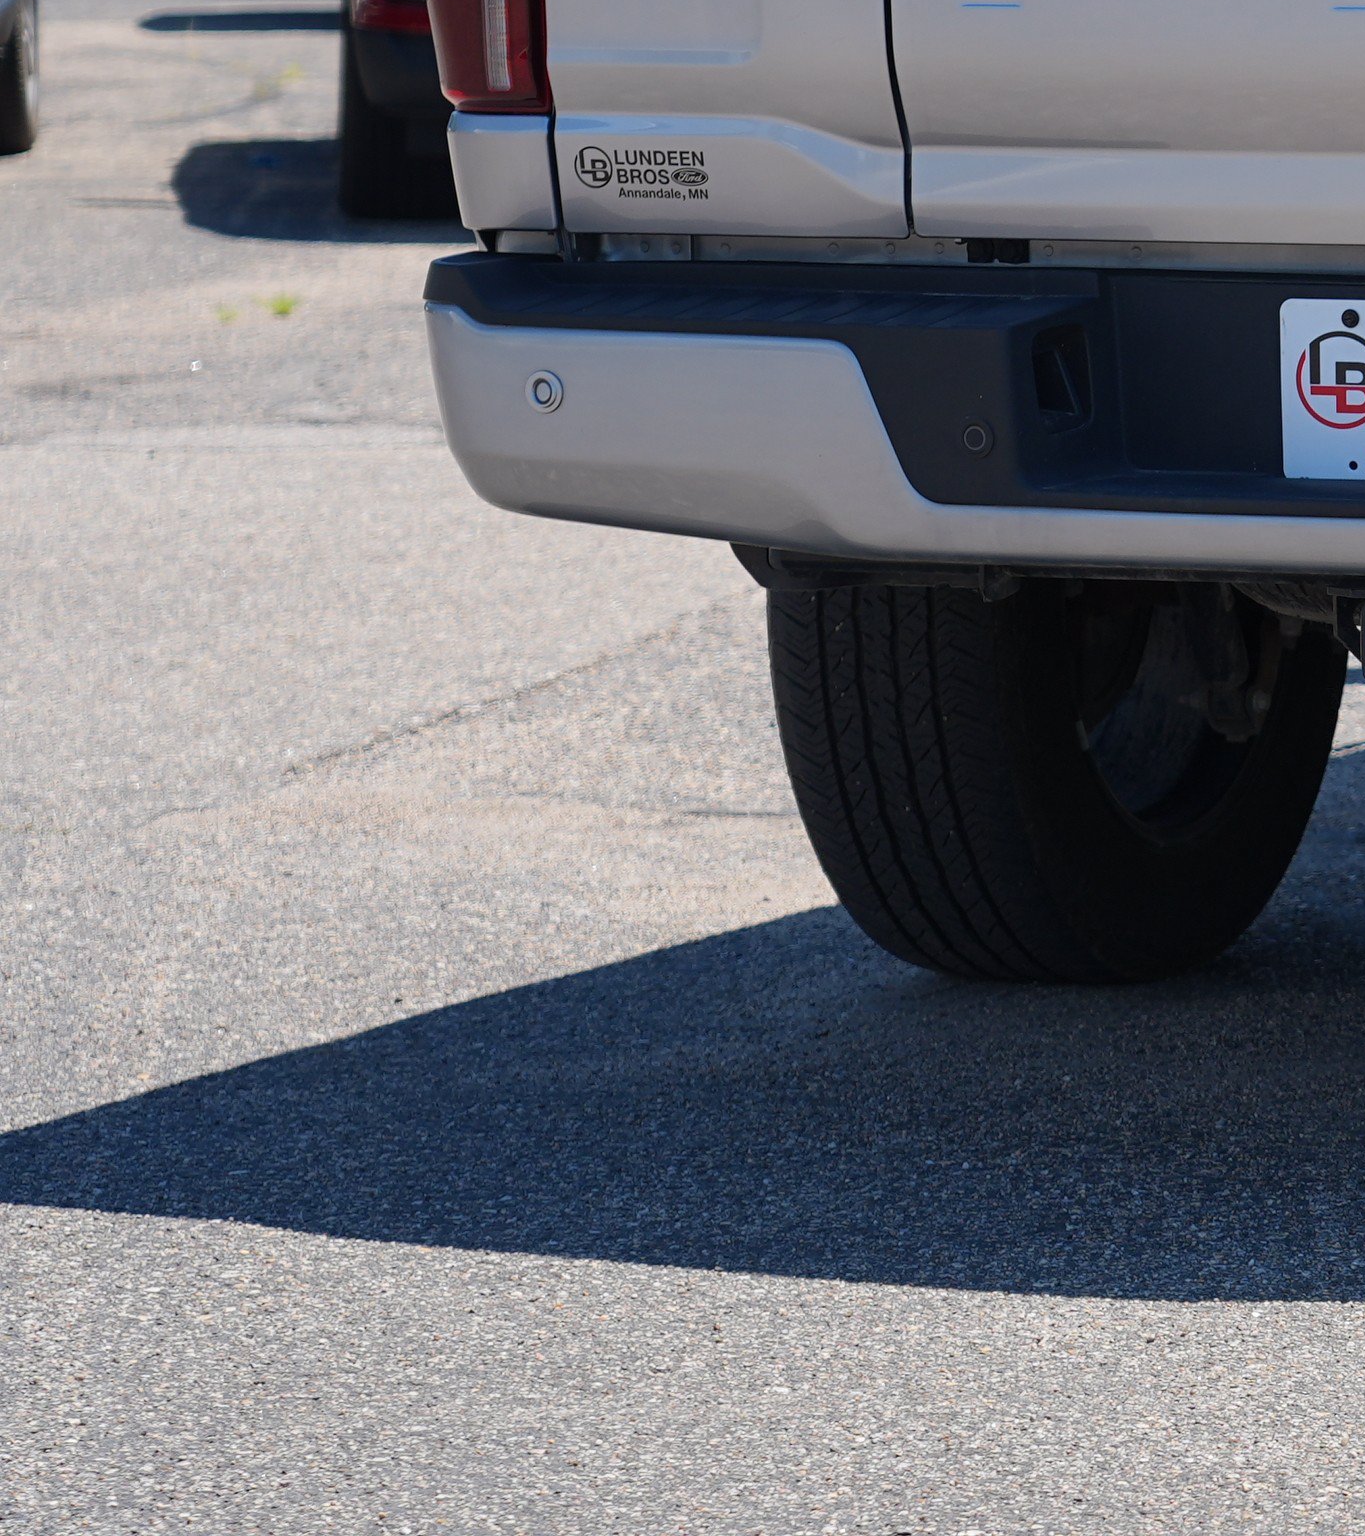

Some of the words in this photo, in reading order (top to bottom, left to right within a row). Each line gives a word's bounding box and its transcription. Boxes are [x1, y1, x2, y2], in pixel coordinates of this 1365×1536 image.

[614, 149, 705, 167] LUNDEEN
[616, 168, 670, 185] BROS
[618, 187, 686, 201] Annandale,
[688, 189, 709, 199] MN
